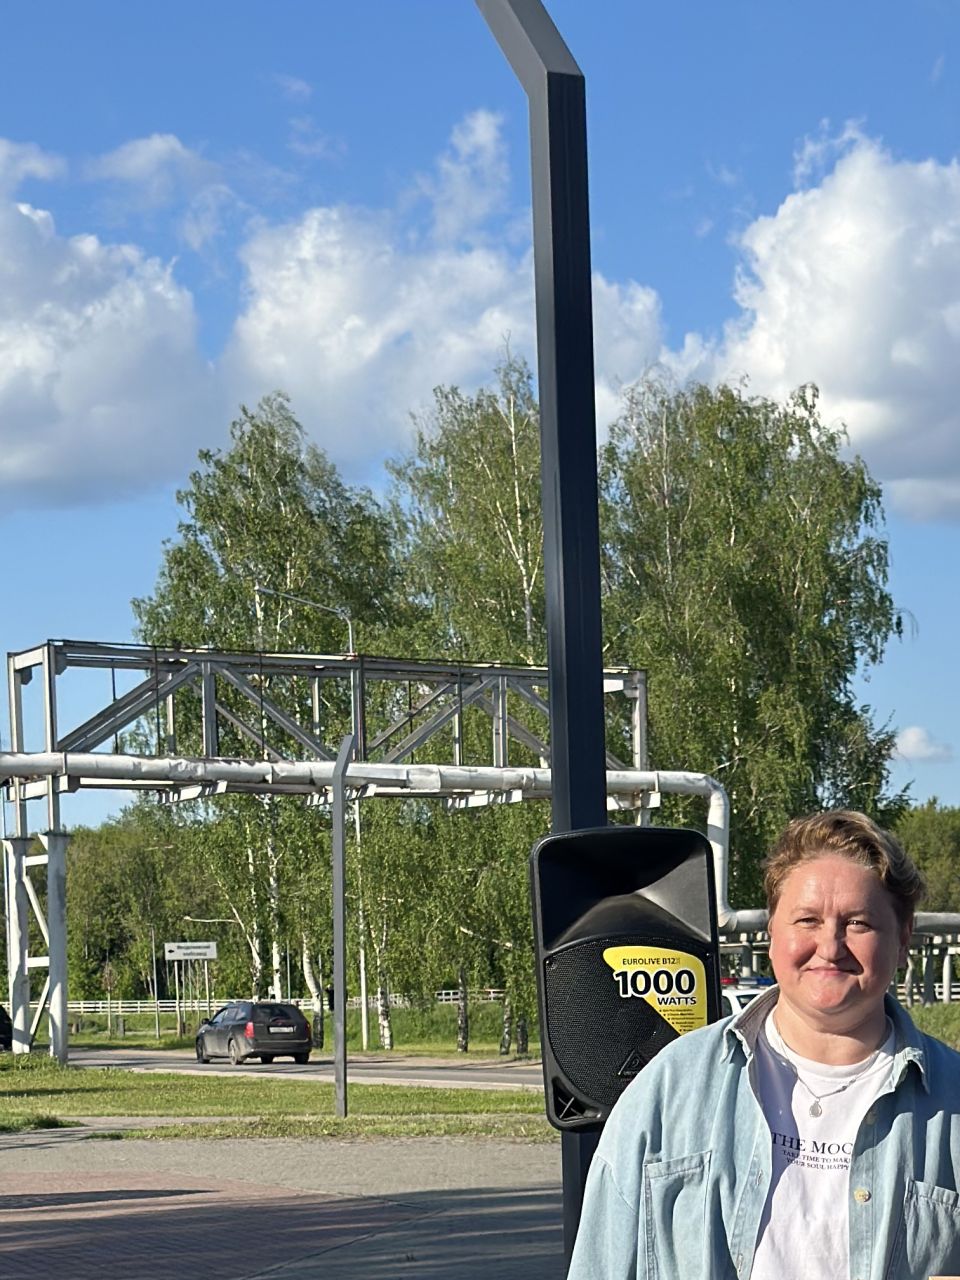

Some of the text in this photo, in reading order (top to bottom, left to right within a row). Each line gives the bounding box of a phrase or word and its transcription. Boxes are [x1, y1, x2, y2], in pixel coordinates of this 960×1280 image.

[622, 958, 660, 966] EUROLIVE
[615, 969, 695, 995] 1000
[657, 997, 696, 1006] WATTS
[771, 1132, 806, 1152] THE
